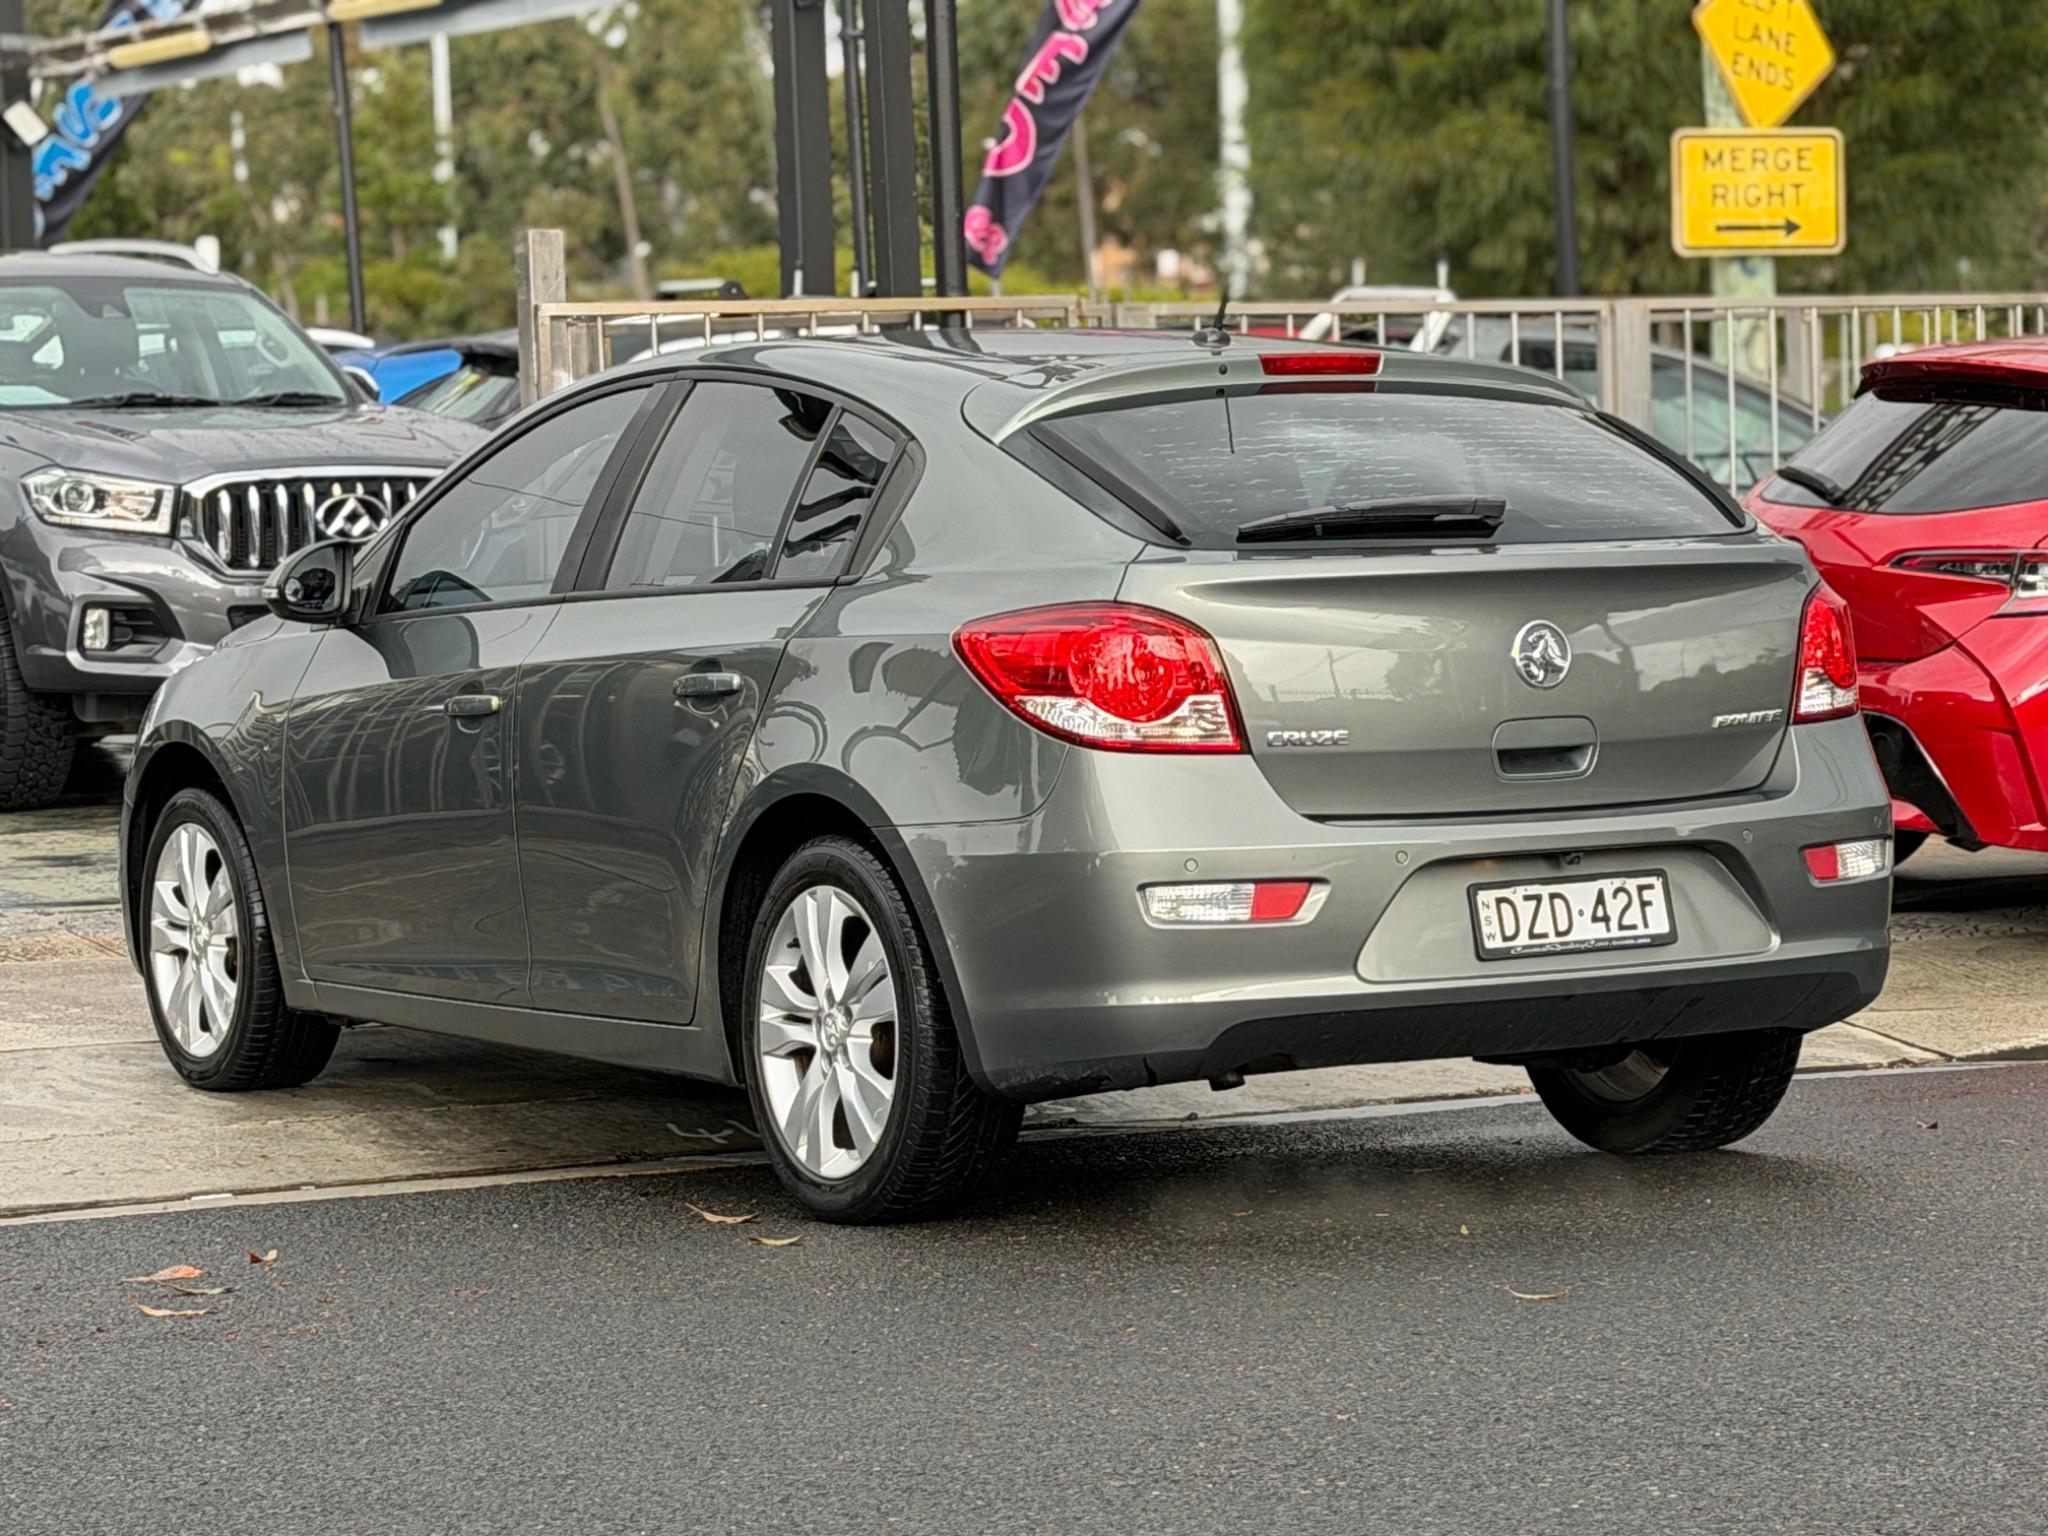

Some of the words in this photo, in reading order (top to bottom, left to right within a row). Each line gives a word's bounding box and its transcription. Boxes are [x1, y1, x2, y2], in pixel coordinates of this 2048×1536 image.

[1734, 16, 1796, 57] LANE
[1732, 52, 1794, 90] ENDS
[1703, 147, 1813, 172] MERGE
[1711, 183, 1805, 208] RIGHT
[1267, 729, 1350, 748] CRUZE
